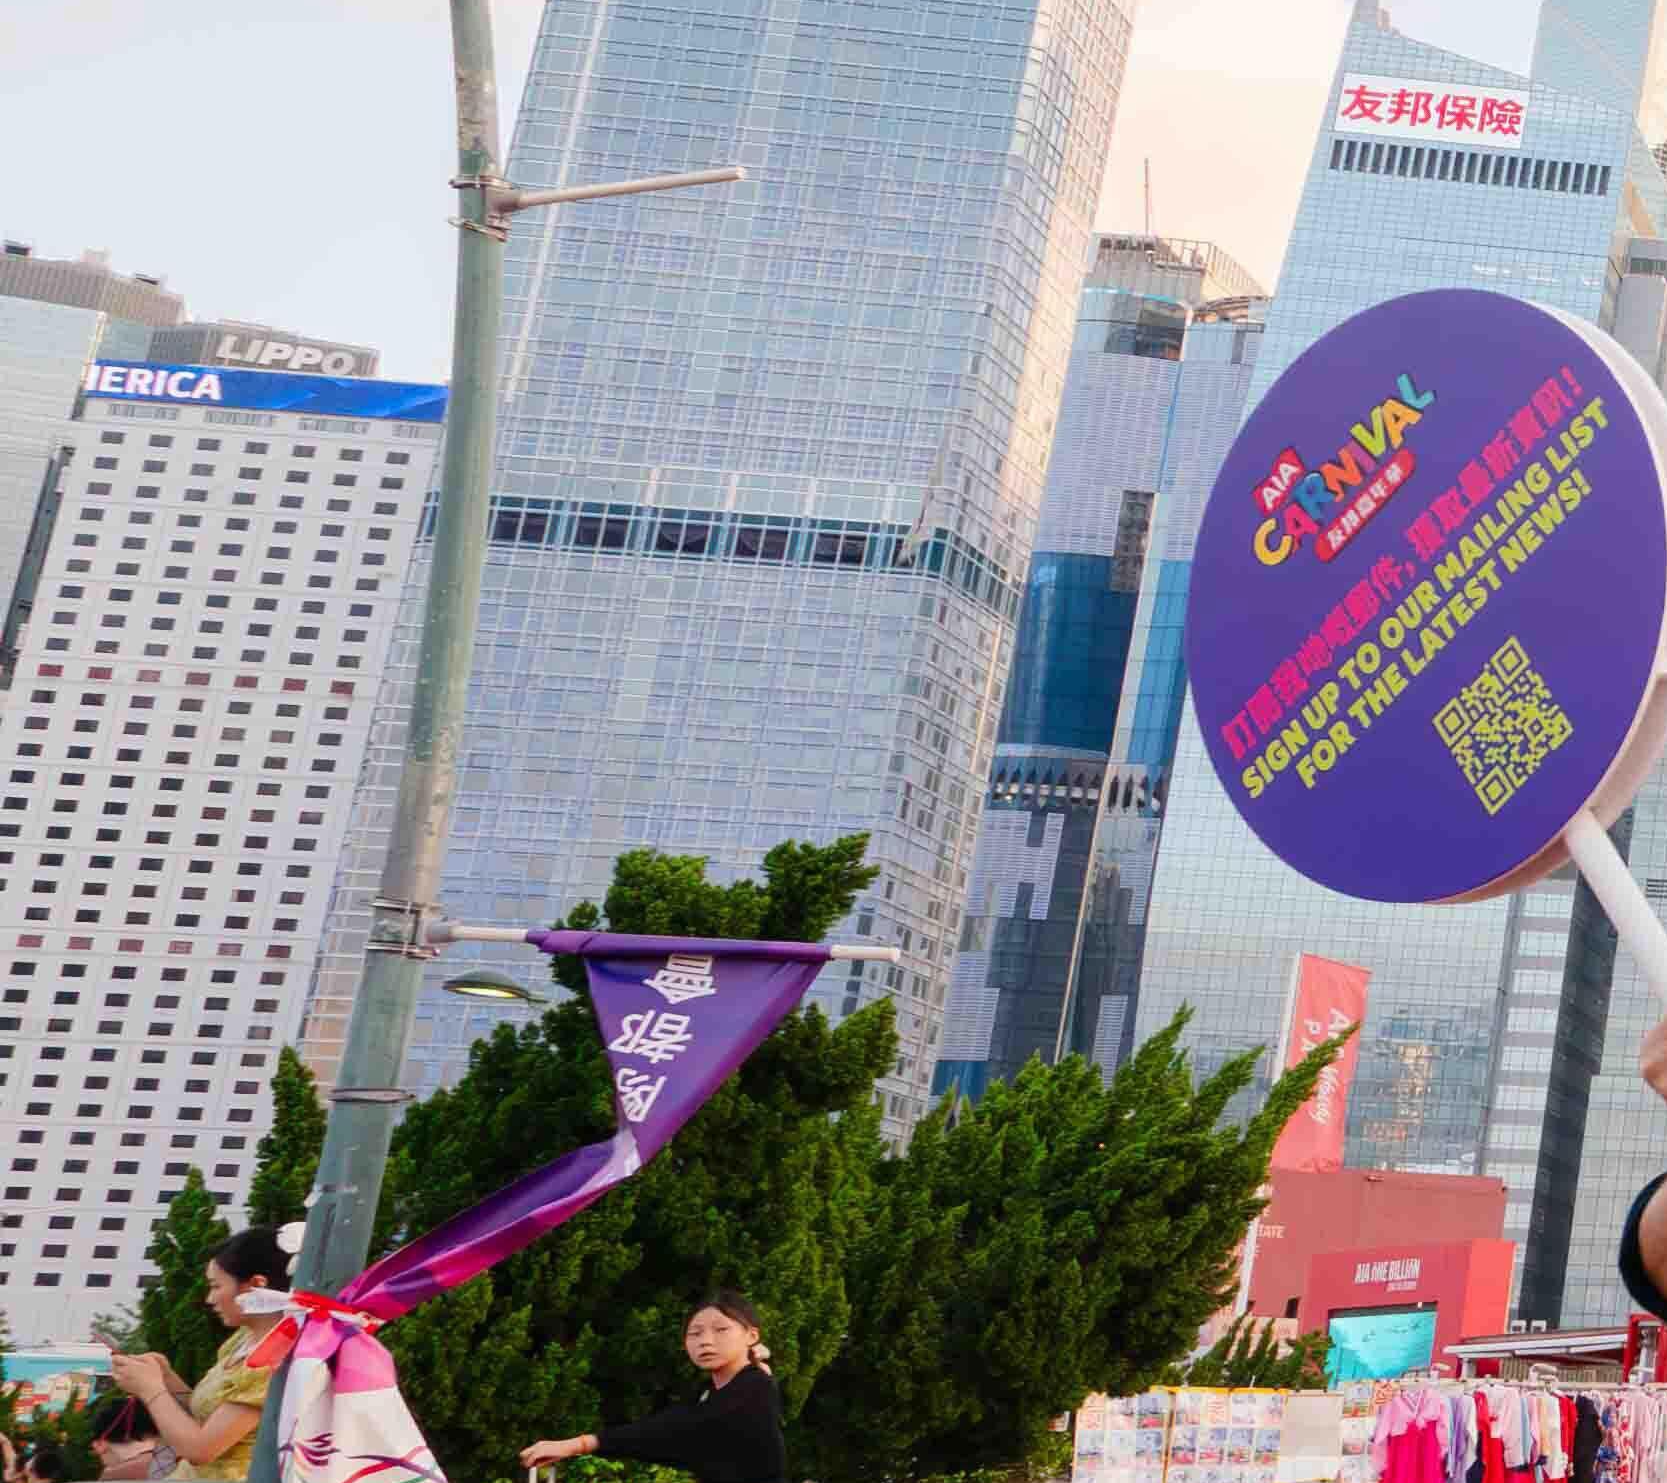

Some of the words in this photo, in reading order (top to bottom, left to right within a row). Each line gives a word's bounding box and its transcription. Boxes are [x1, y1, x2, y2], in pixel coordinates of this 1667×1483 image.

[1341, 85, 1524, 136] 友邦保險
[216, 334, 356, 375] LIPPO
[1254, 373, 1434, 566] CARNIVAL
[1262, 463, 1299, 509] AIA
[1242, 719, 1309, 798] SIGN
[1302, 681, 1340, 730] UP
[1338, 641, 1381, 690] TO
[1380, 580, 1442, 649] OUR
[1434, 462, 1552, 592] MAILING
[1545, 396, 1608, 473] LIST
[1296, 720, 1355, 789] FOR
[1348, 662, 1409, 728] THE
[1401, 558, 1502, 676] LATEST
[1498, 468, 1592, 573] NEWS!
